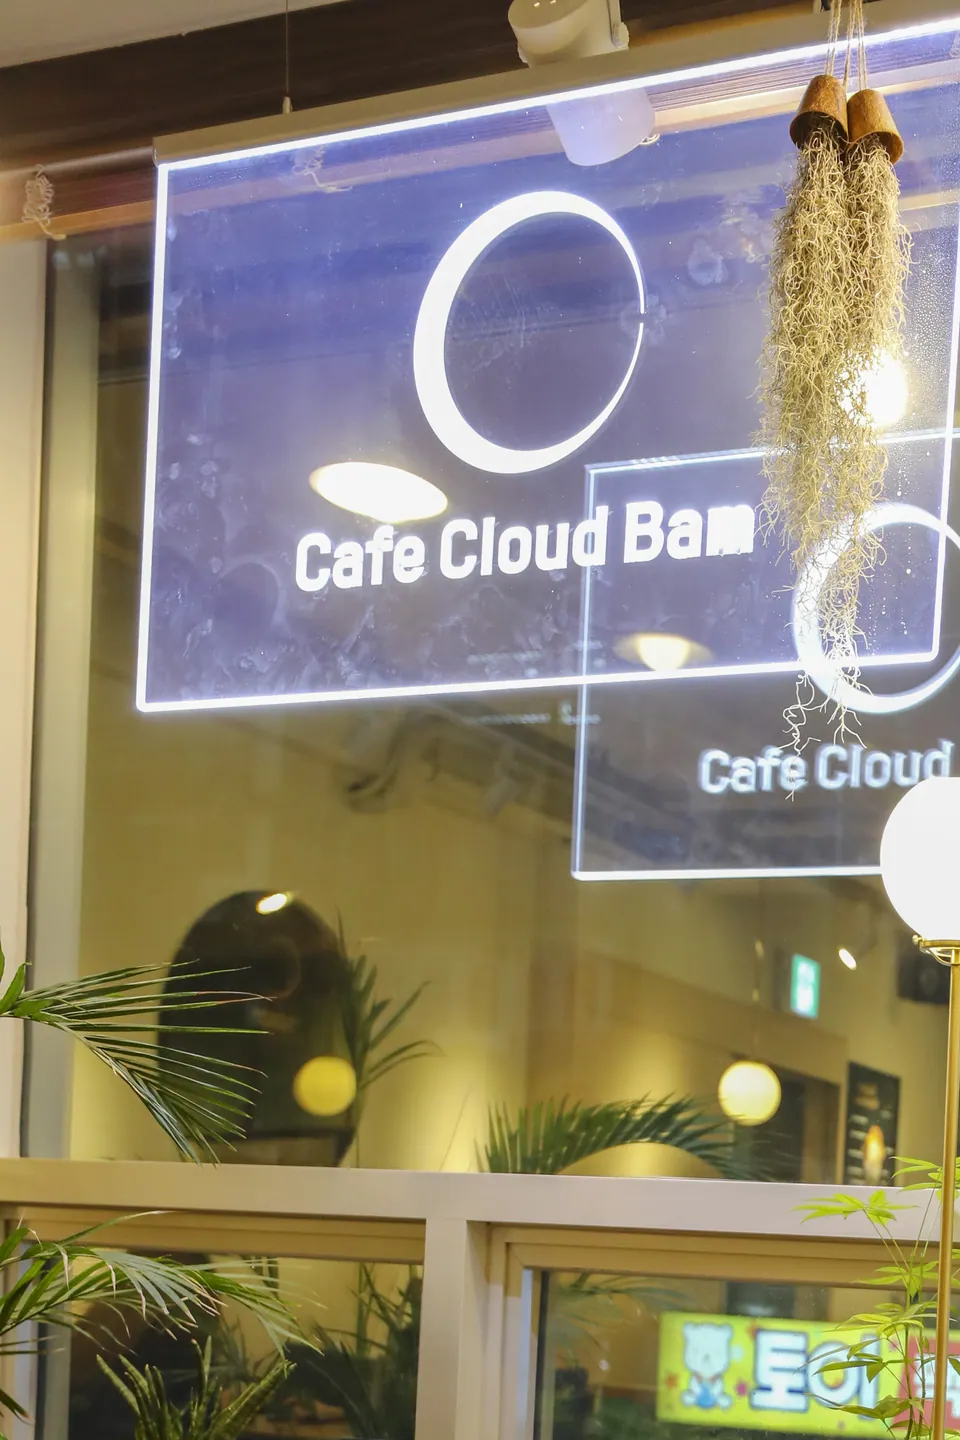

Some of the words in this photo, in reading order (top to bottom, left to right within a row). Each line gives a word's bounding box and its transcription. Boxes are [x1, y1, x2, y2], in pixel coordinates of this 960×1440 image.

[295, 523, 426, 593] Cafe
[441, 505, 609, 580] Cloud
[623, 500, 756, 564] Bam
[700, 744, 808, 795] Cafe
[815, 739, 956, 790] Cloud
